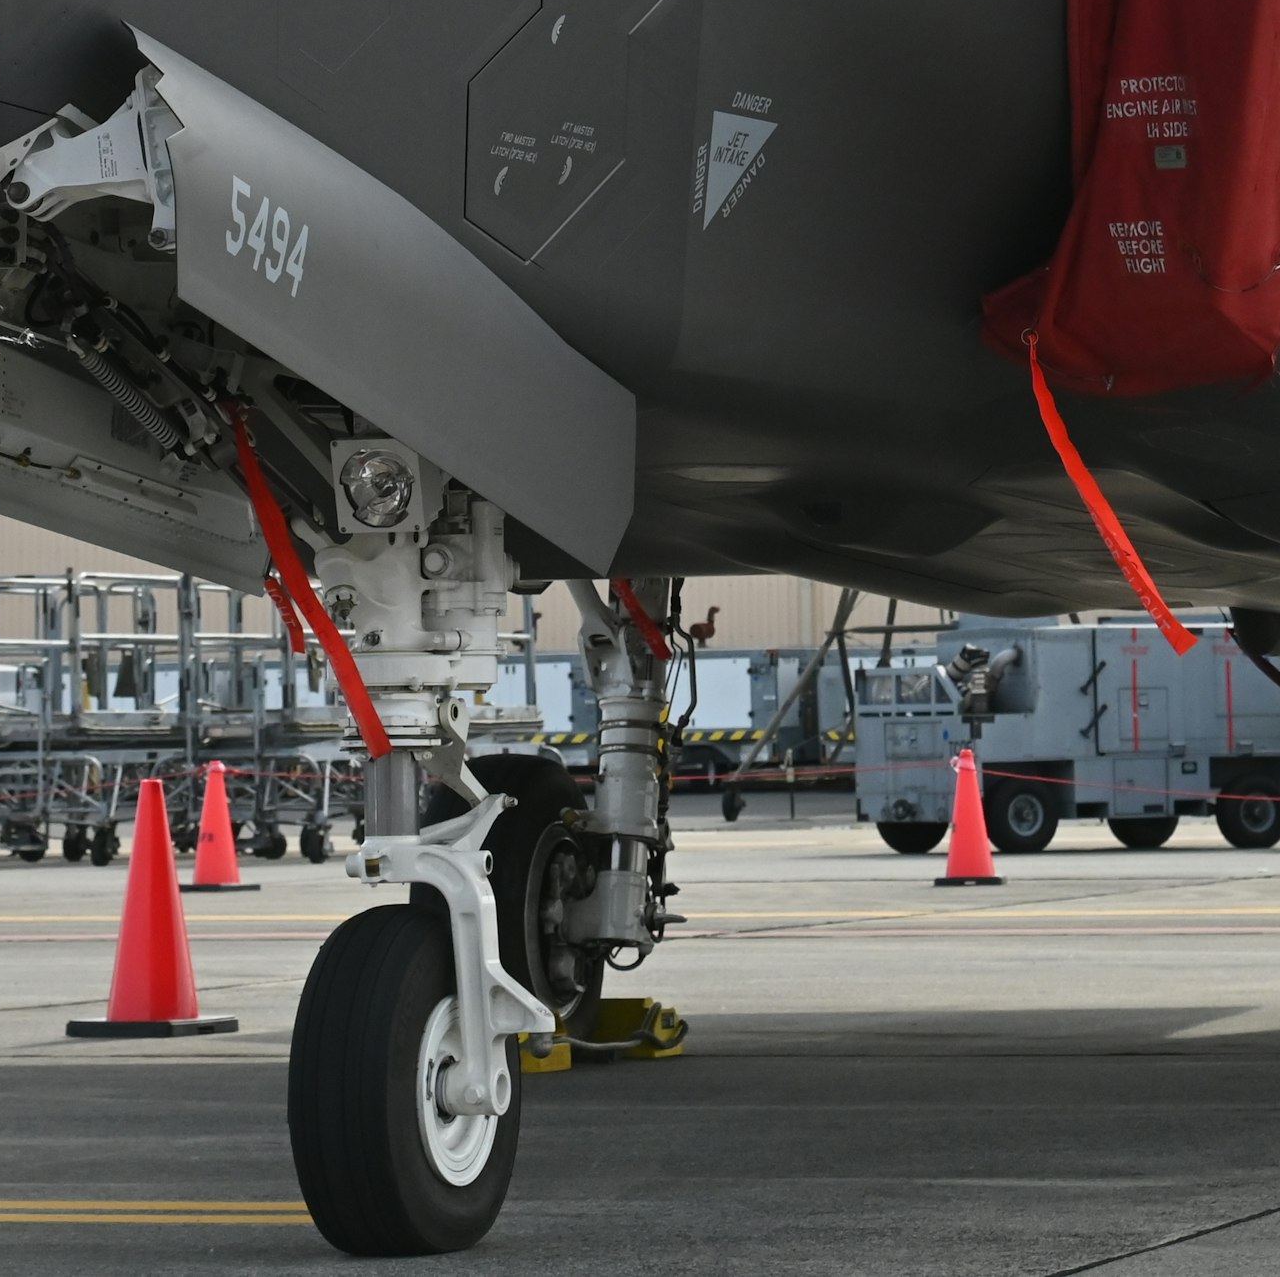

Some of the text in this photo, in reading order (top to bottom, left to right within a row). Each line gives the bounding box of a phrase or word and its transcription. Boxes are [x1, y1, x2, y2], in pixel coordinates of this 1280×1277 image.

[731, 91, 773, 114] DANGER
[1106, 100, 1158, 119] ENGINE
[1162, 99, 1181, 115] AIR
[573, 124, 595, 137] MASTER
[1147, 121, 1189, 139] LH SIDE
[514, 133, 536, 147] MASTER
[727, 131, 750, 148] JET
[713, 147, 750, 167] INTAKE
[692, 142, 709, 214] DANGER
[721, 152, 767, 219] DANGER
[225, 174, 309, 298] 5494
[1108, 220, 1164, 237] REMOVE
[1118, 239, 1164, 255] BEFORE
[1125, 257, 1166, 274] FLIGHT
